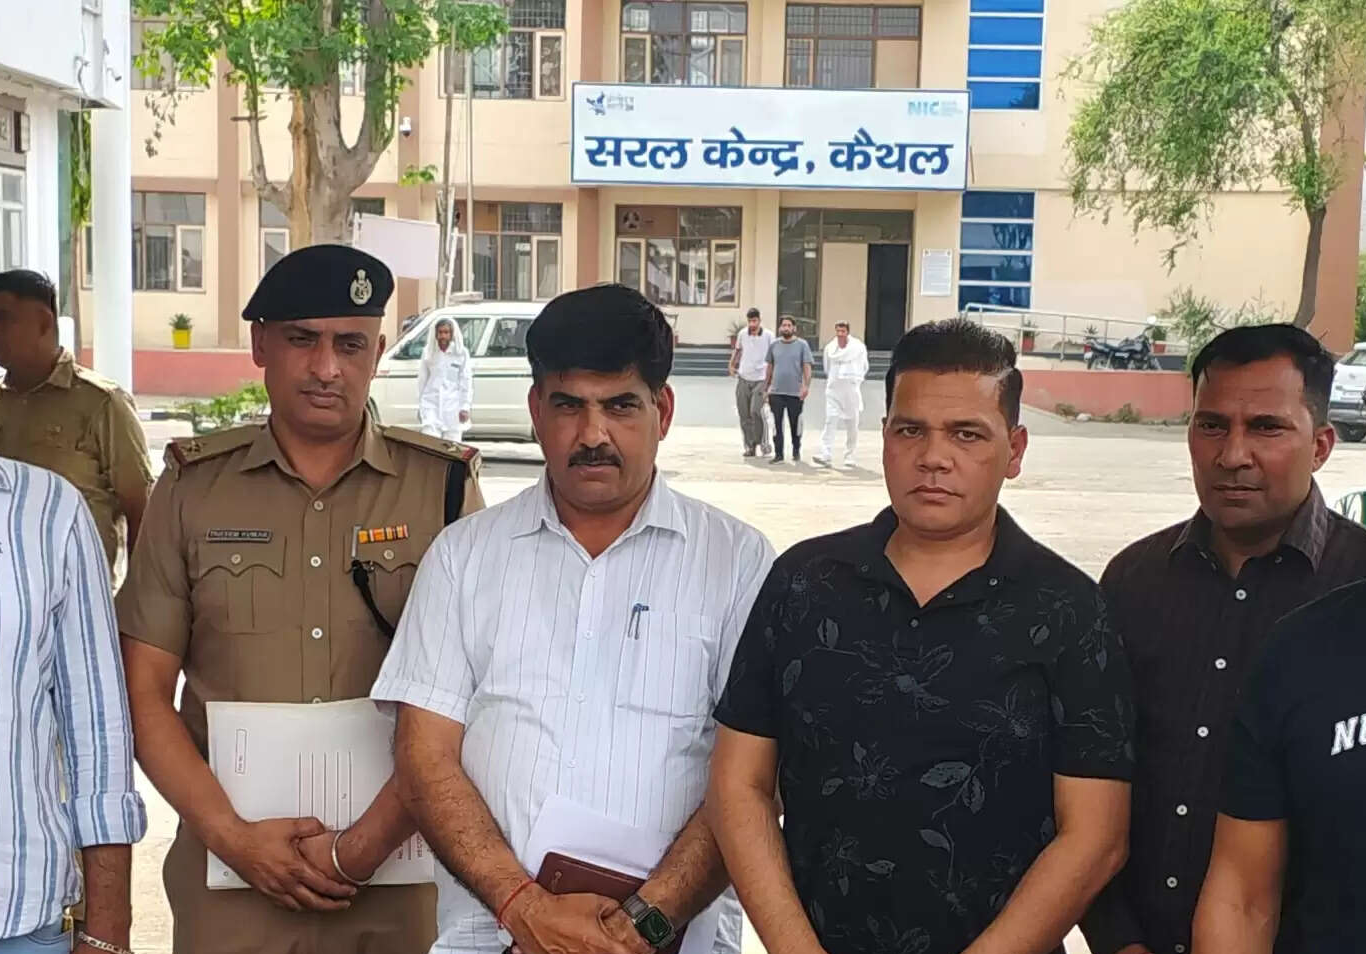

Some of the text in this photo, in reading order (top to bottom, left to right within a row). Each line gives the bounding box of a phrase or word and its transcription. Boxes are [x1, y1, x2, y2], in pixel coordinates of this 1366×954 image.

[584, 126, 954, 177] सरल केन्द्र, कैथल
